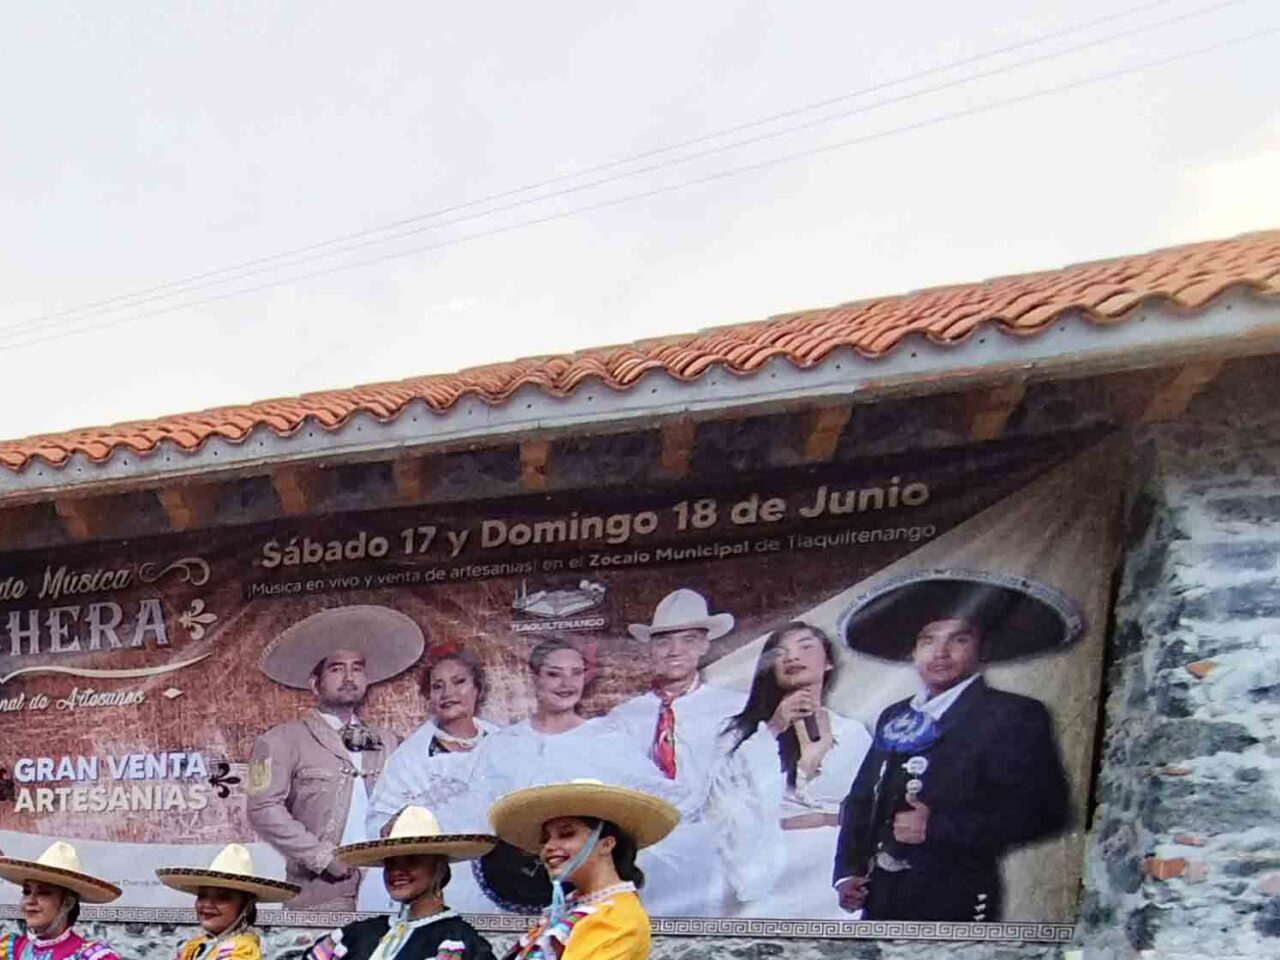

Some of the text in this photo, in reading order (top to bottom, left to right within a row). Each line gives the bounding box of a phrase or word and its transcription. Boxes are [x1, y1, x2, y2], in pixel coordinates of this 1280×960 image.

[261, 475, 930, 569] Sábado 17 y Domingo 18 de Junio
[306, 578, 324, 591] en
[328, 574, 359, 588] vivo
[364, 573, 373, 587] y
[377, 569, 420, 584] venta
[424, 567, 446, 582] de
[542, 559, 563, 572] en
[656, 540, 749, 561] Municipal
[754, 537, 780, 552] de
[786, 523, 937, 549] Tlaquiltenango
[28, 694, 48, 710] de
[55, 686, 147, 711] Artesanos
[14, 752, 207, 783] GRAN VENTA
[14, 784, 209, 813] ARTESANIAS
